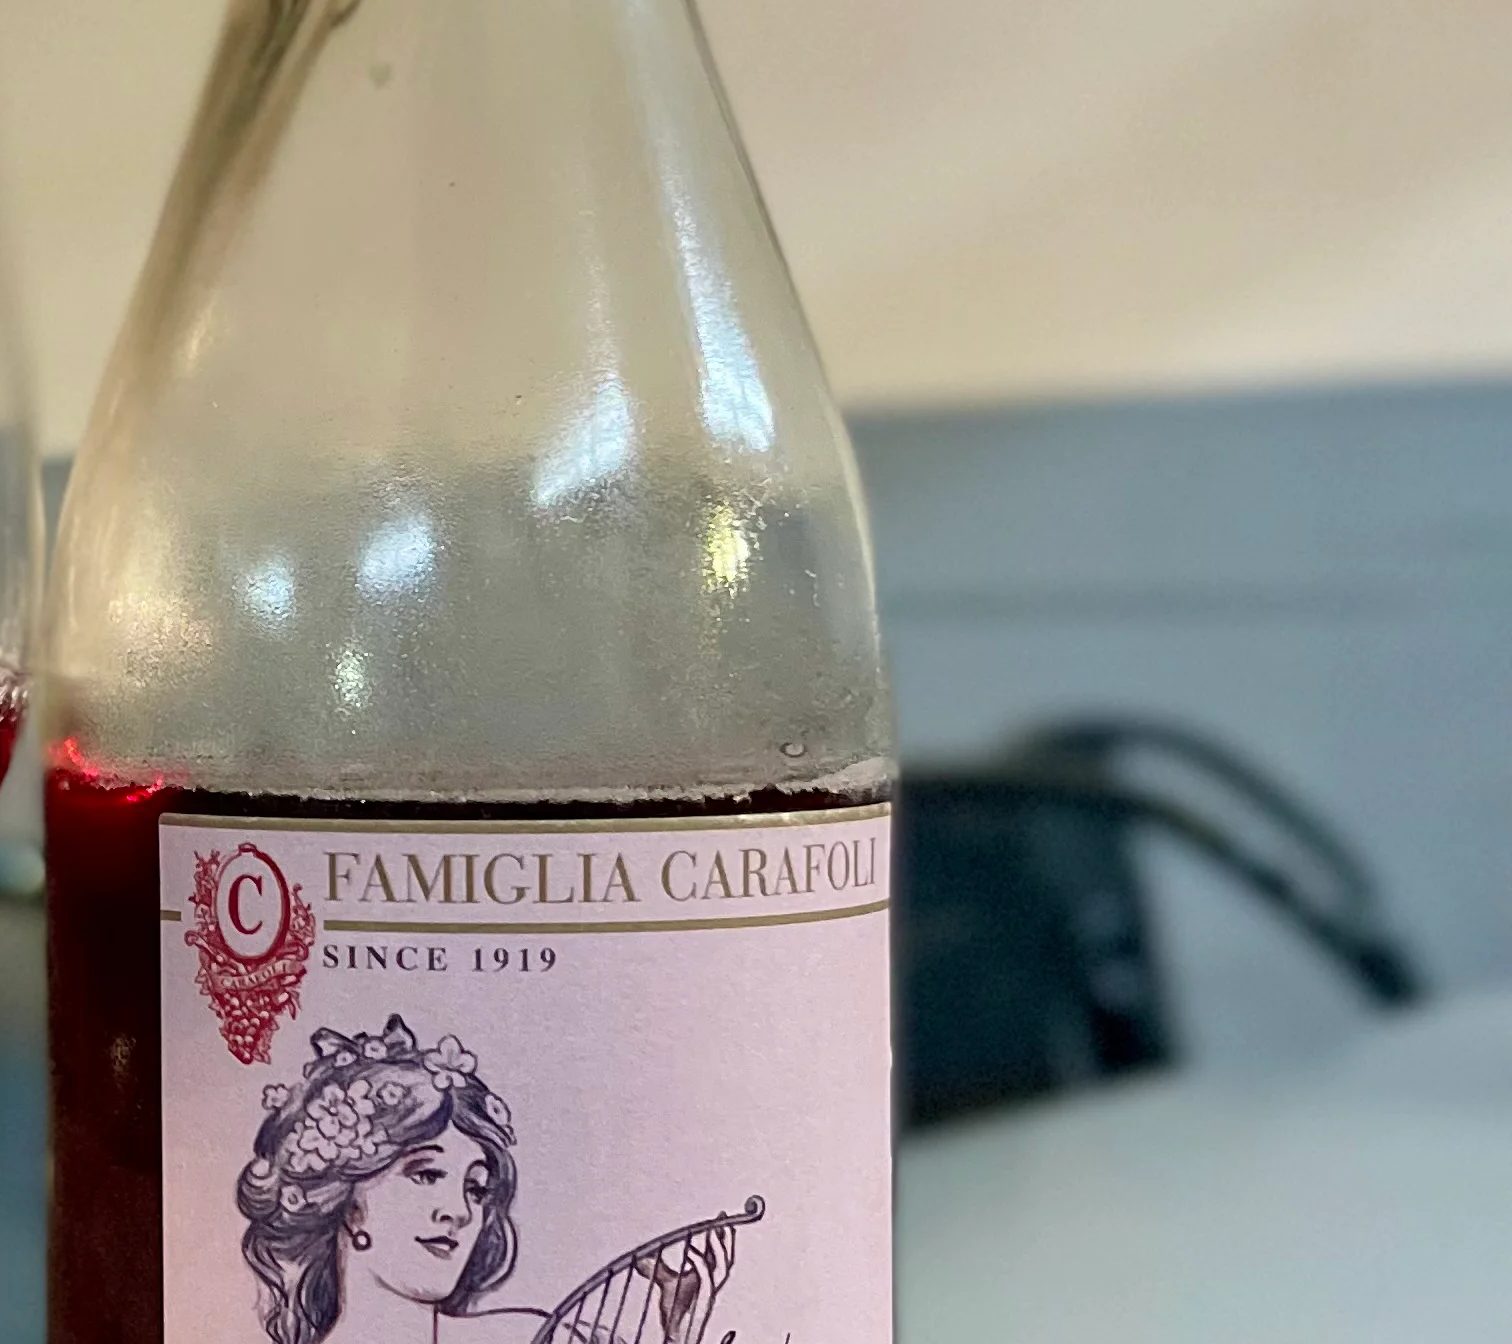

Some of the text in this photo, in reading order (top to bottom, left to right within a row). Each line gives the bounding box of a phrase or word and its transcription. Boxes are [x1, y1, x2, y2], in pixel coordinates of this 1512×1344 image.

[323, 837, 877, 905] FAMIGLIA CARAFOLI
[228, 873, 263, 935] C
[323, 944, 557, 973] SINCE 1919
